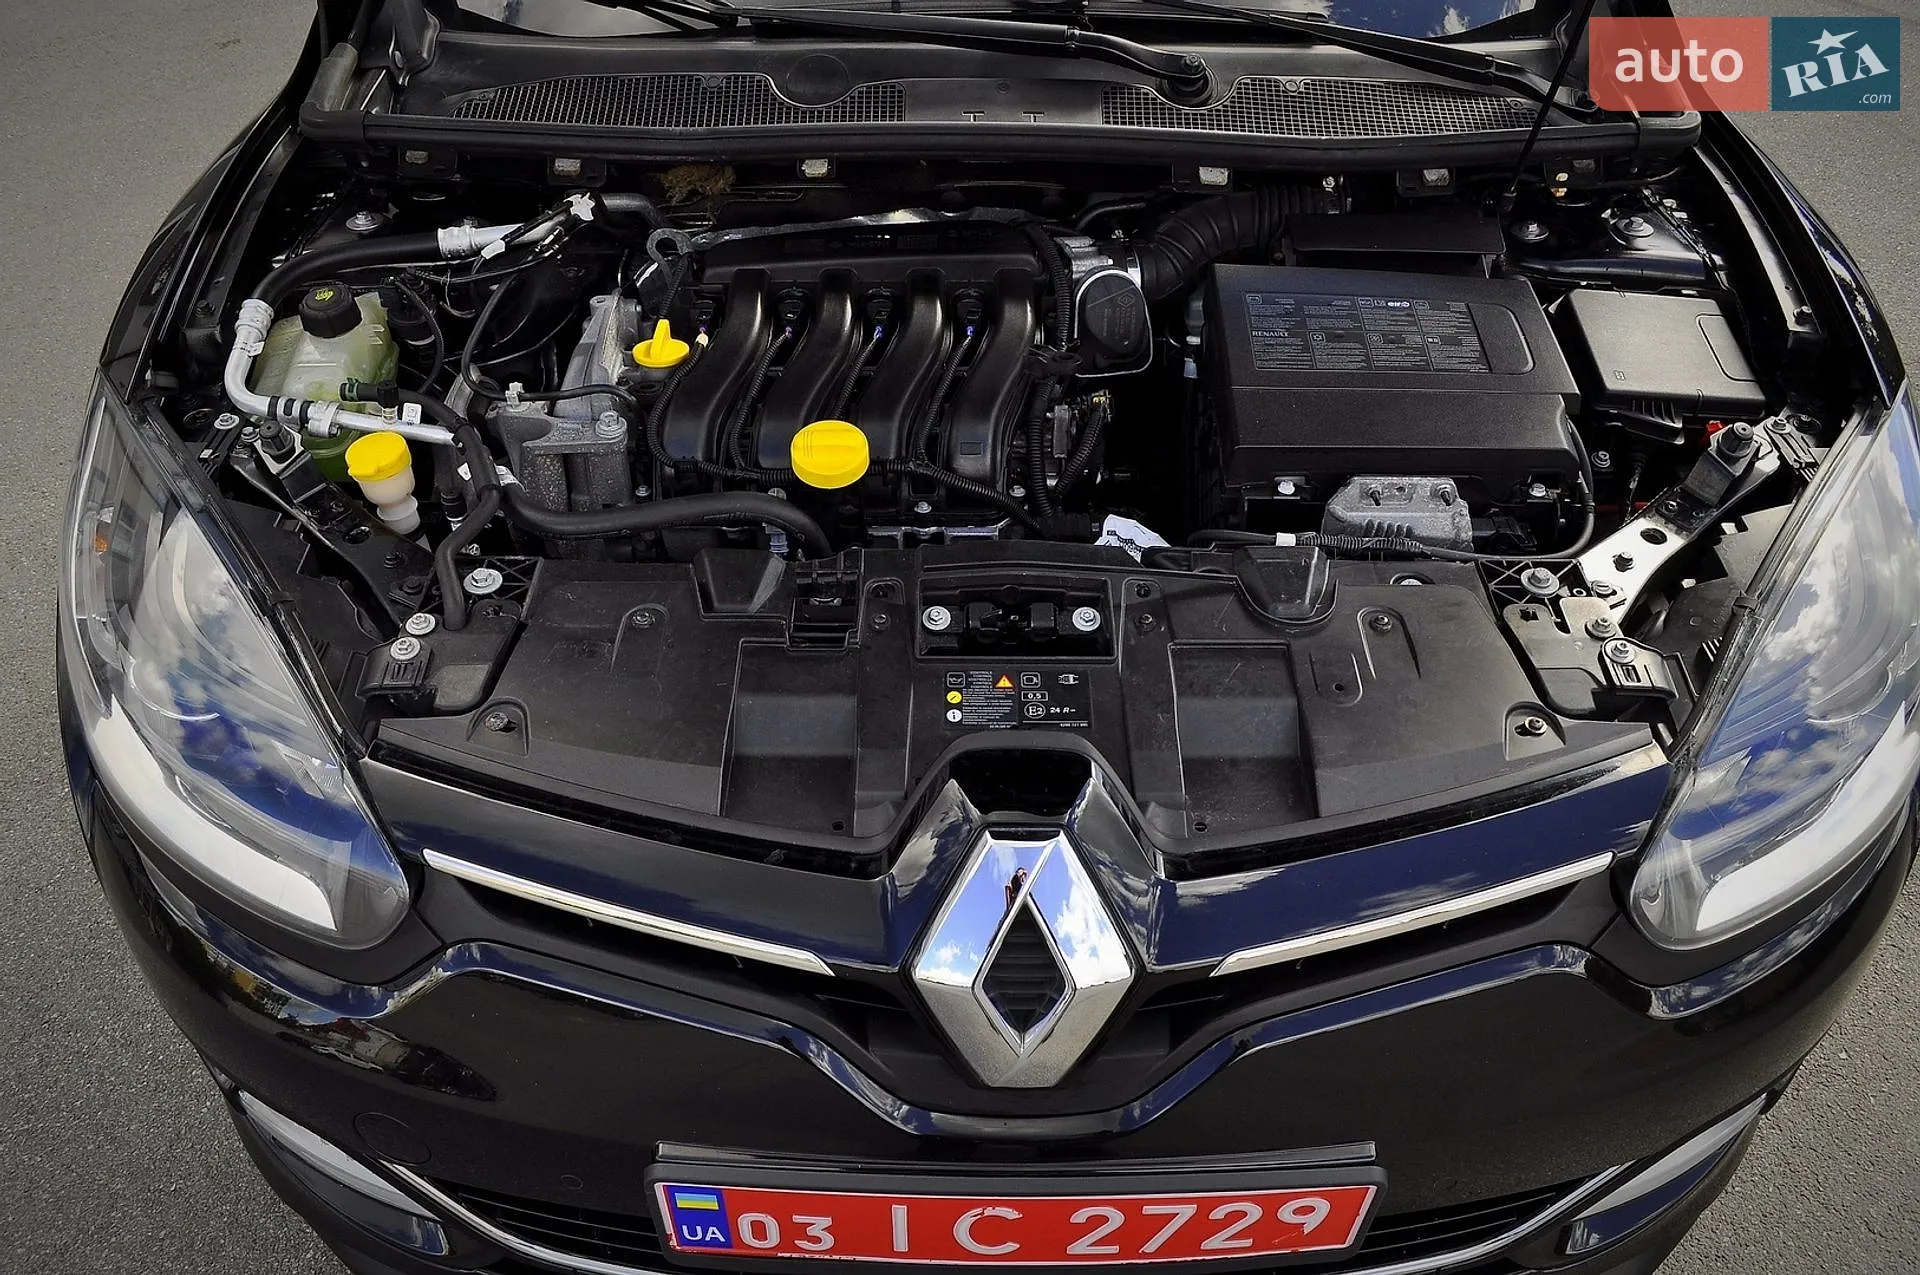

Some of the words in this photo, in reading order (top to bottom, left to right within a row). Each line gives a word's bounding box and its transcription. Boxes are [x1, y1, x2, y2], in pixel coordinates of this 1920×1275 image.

[1028, 705, 1044, 716] E2
[682, 1224, 726, 1242] UA
[737, 1212, 835, 1251] 03
[1066, 1198, 1331, 1255] 2729
